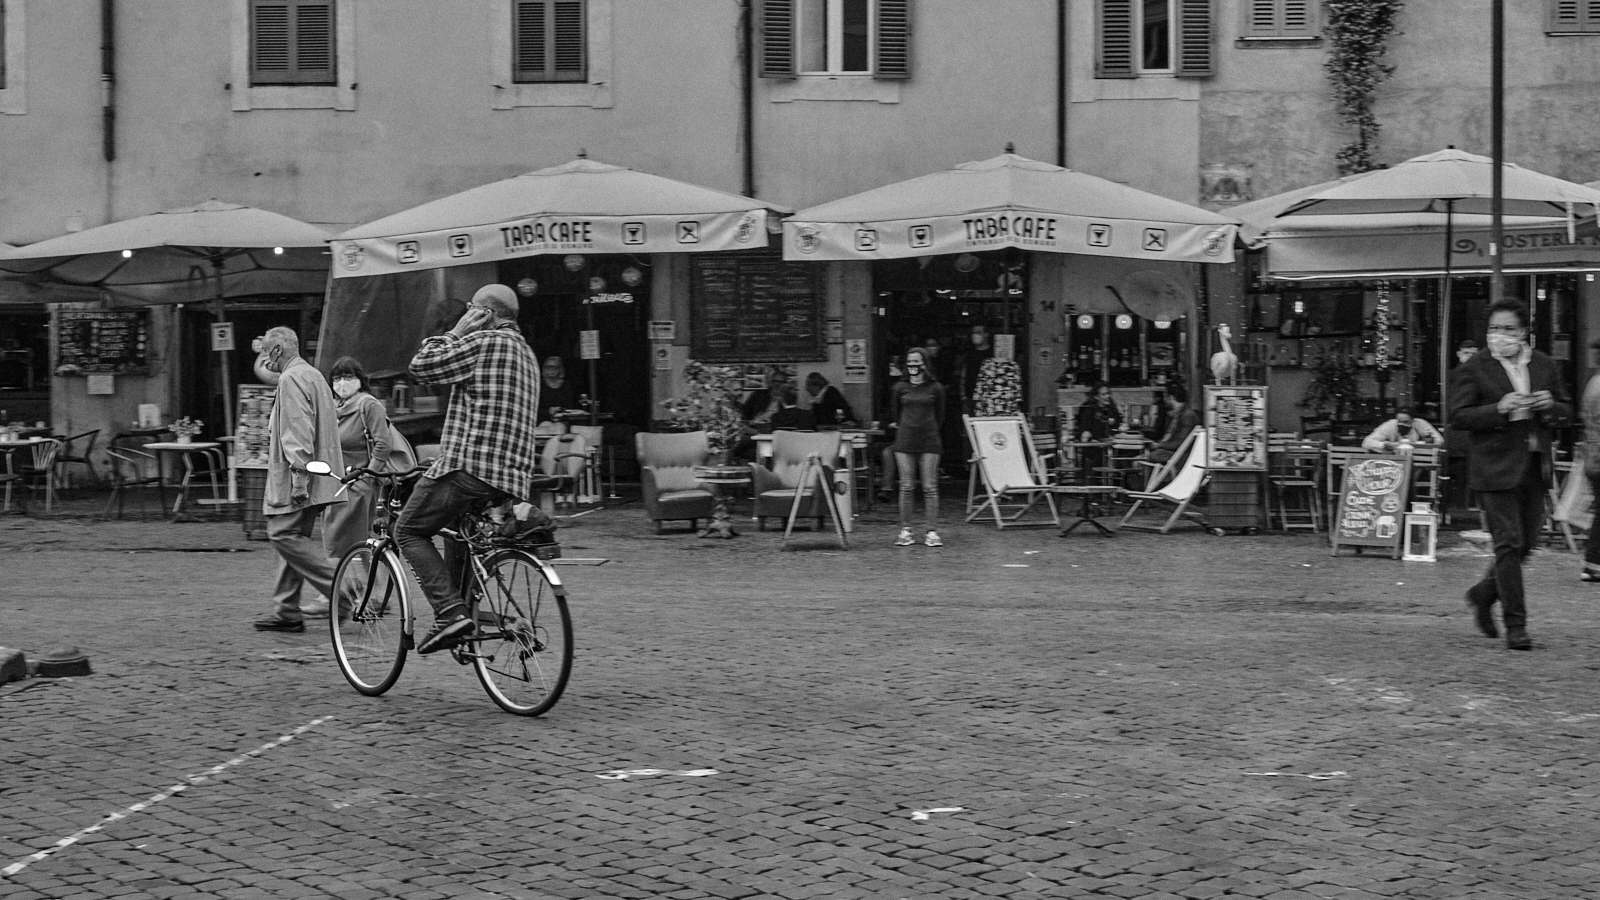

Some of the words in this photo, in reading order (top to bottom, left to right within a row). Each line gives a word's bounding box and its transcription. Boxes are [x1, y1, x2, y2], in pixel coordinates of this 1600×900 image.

[500, 222, 545, 248] TABA
[549, 221, 592, 243] CAFE
[963, 216, 1008, 240] TABA
[1012, 216, 1056, 240] CAFE
